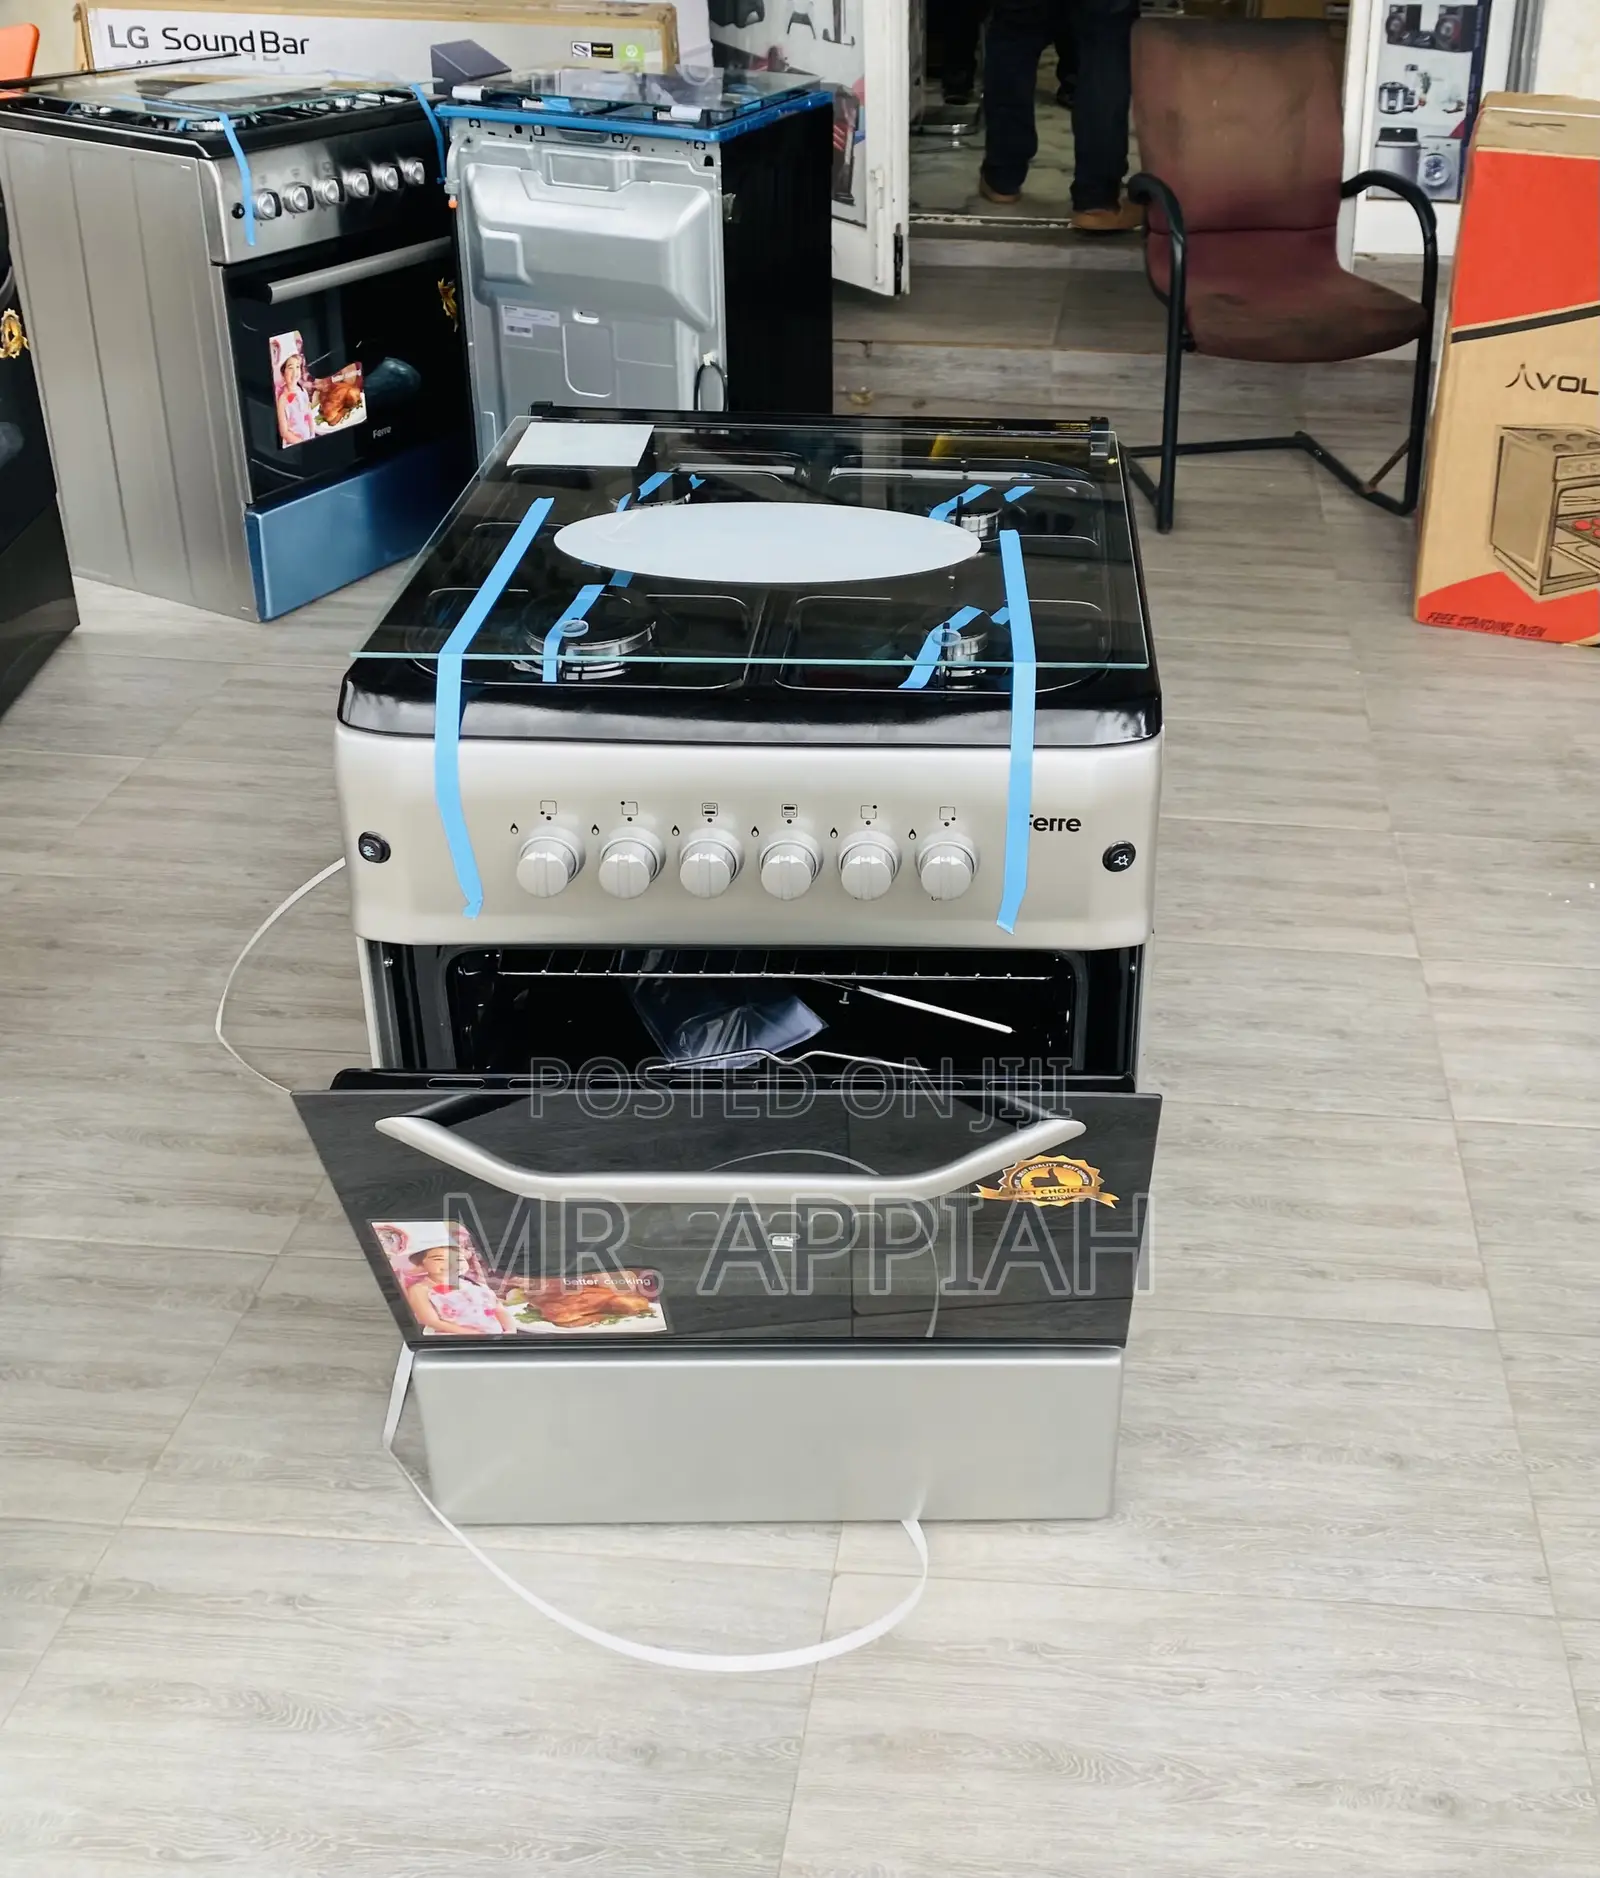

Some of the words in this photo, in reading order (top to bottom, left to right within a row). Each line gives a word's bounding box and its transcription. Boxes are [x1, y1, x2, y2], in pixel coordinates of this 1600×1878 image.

[107, 24, 149, 49] LG
[1426, 611, 1459, 626] FREE
[1513, 623, 1548, 638] OVEN
[1029, 814, 1082, 832] erre
[1028, 1162, 1058, 1171] QUALITY
[1040, 1187, 1085, 1195] CHOICE
[563, 1278, 599, 1286] better
[603, 1277, 651, 1287] cooking
